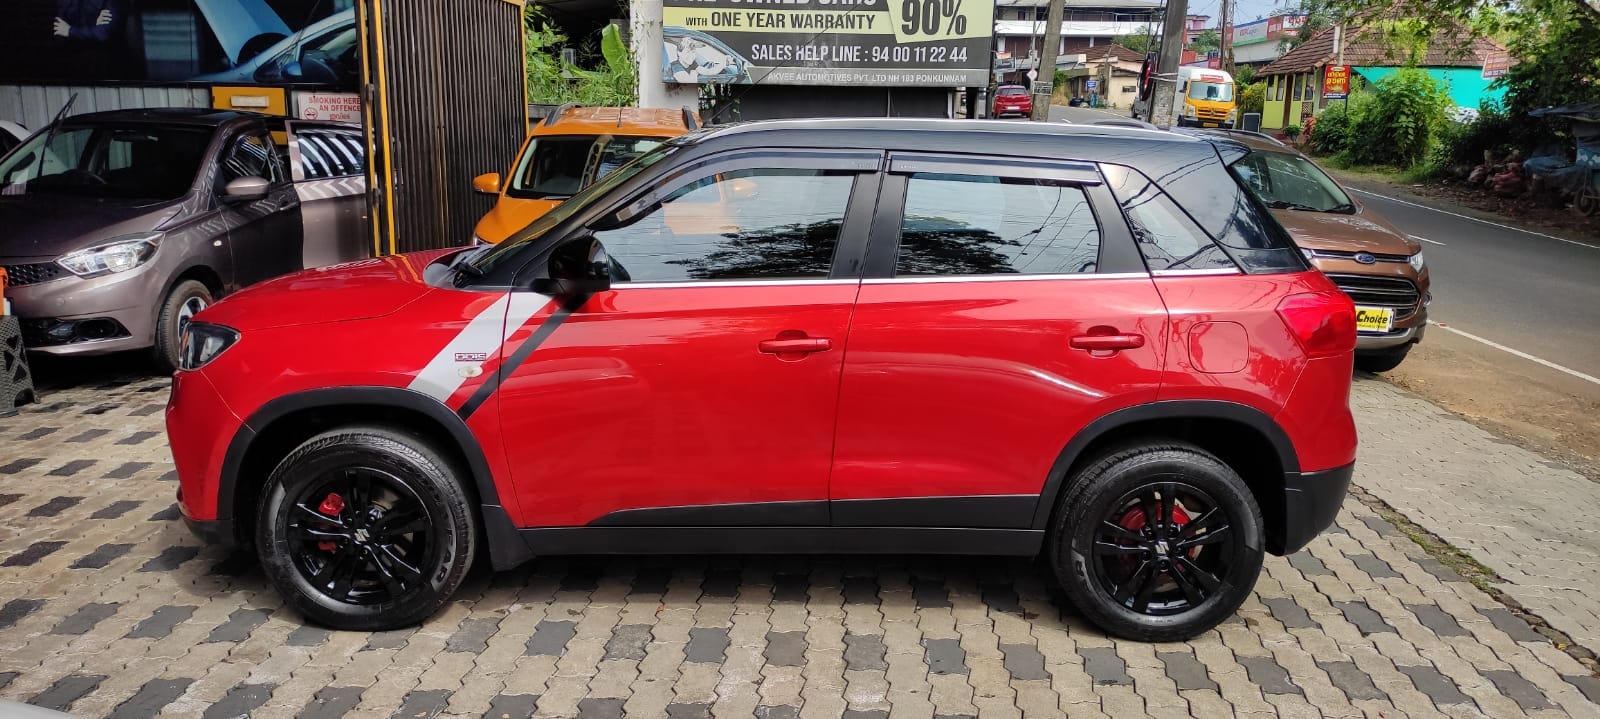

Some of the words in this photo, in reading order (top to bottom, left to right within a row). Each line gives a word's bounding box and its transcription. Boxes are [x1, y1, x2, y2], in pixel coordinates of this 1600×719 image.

[685, 17, 708, 27] WITH
[711, 12, 742, 27] ONE
[746, 12, 786, 29] YEAR
[790, 14, 876, 30] WARRANTY
[901, 0, 967, 36] 90%
[751, 43, 793, 61] SALES
[795, 45, 829, 62] HELP
[832, 45, 861, 62] LINE
[872, 46, 890, 62] 94
[892, 46, 910, 62] 00
[914, 46, 927, 62] 11
[929, 46, 947, 62] 22
[949, 46, 968, 63] 44
[767, 72, 795, 81] AKVEE
[796, 72, 852, 82] AUTOMOTIVES
[872, 74, 887, 82] LTD
[888, 74, 899, 82] NH
[902, 74, 914, 82] 183
[916, 74, 967, 83] PONKUNNAM
[308, 96, 341, 104] SMOKING
[343, 97, 361, 105] HERE
[1356, 310, 1388, 324] Choice
